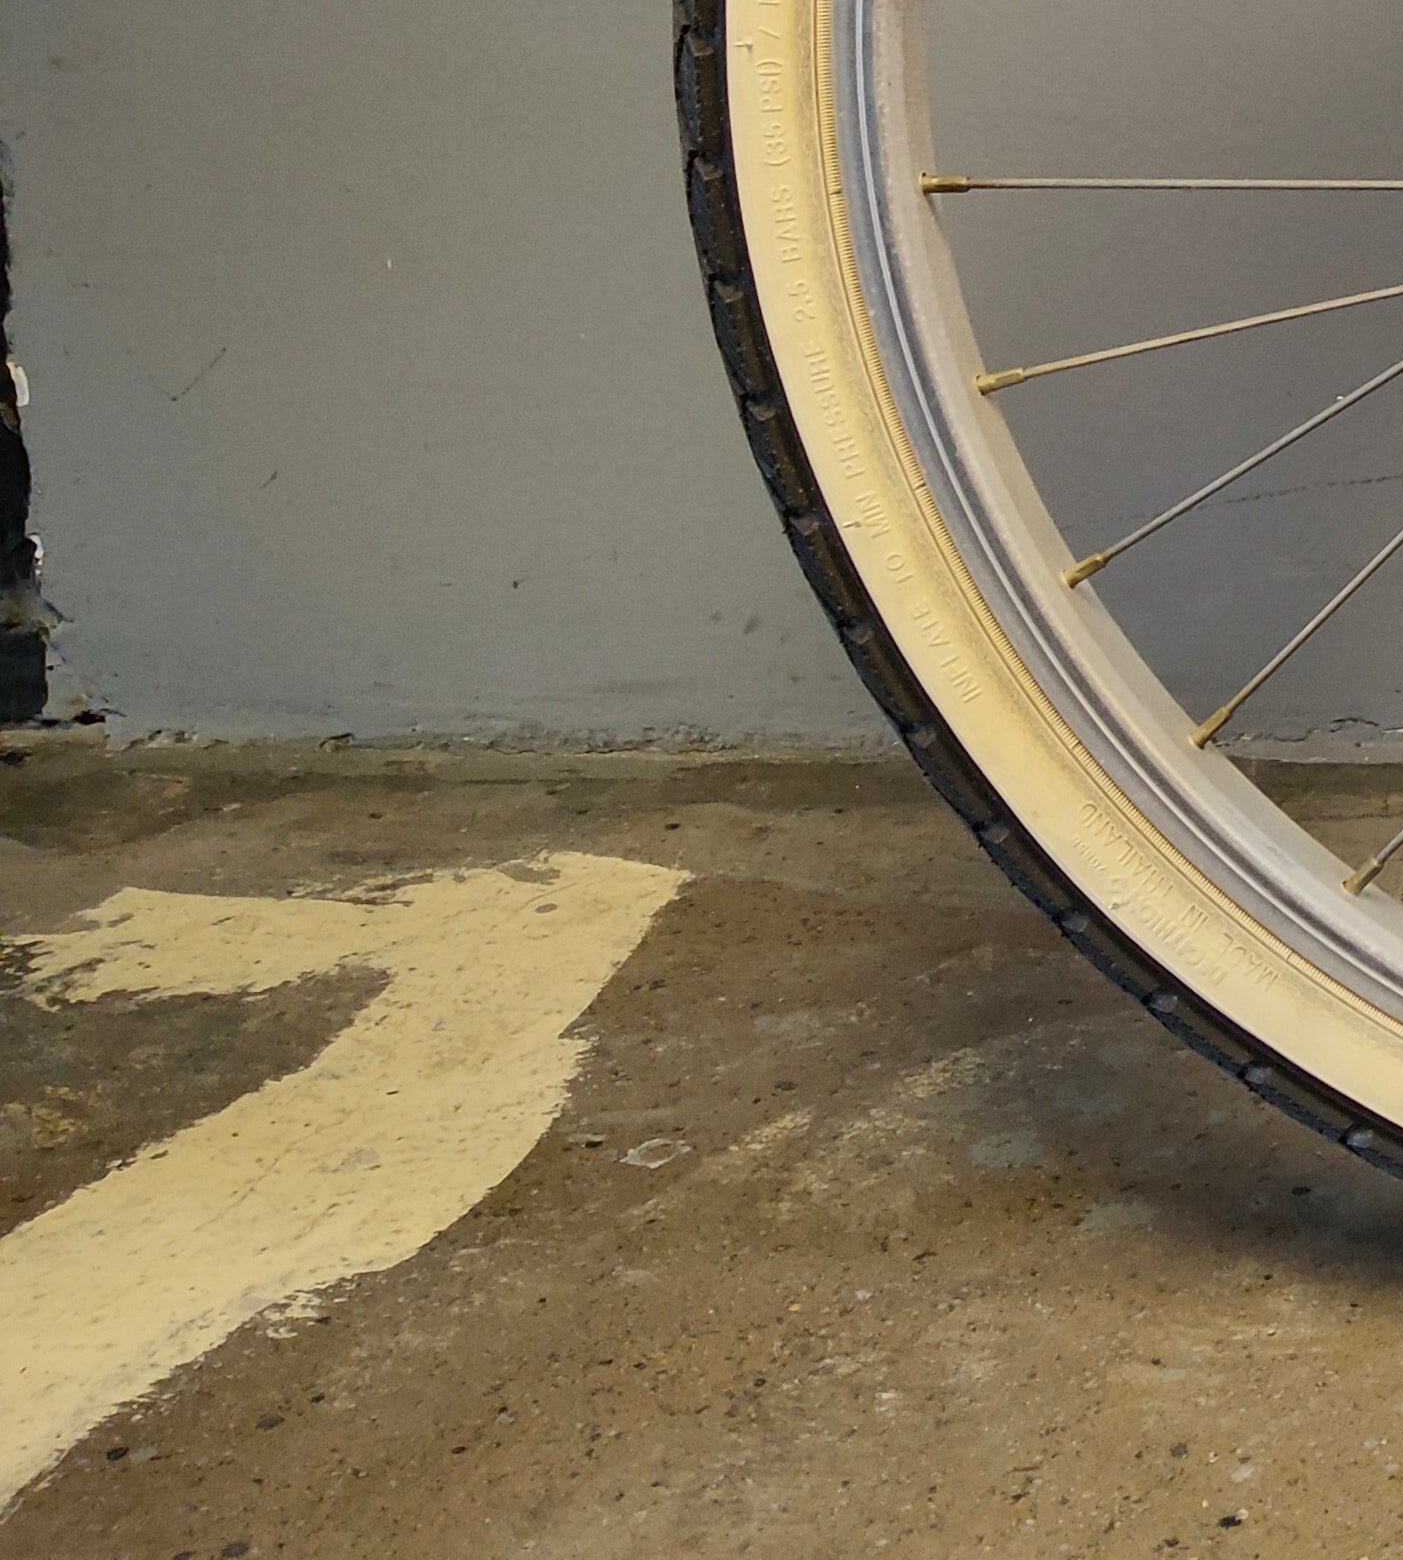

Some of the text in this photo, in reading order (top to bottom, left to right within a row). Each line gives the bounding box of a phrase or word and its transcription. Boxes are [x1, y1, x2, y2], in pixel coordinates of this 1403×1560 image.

[757, 58, 785, 114] PSI)
[761, 123, 791, 169] (35
[769, 184, 802, 264] BARS
[787, 280, 816, 323] 2.5
[804, 346, 864, 480] PRESSURE
[855, 490, 892, 539] MIN
[885, 551, 914, 586] TO
[911, 600, 983, 704] INFLATE
[1079, 802, 1174, 897] THAILAND
[1220, 931, 1280, 993] MADE
